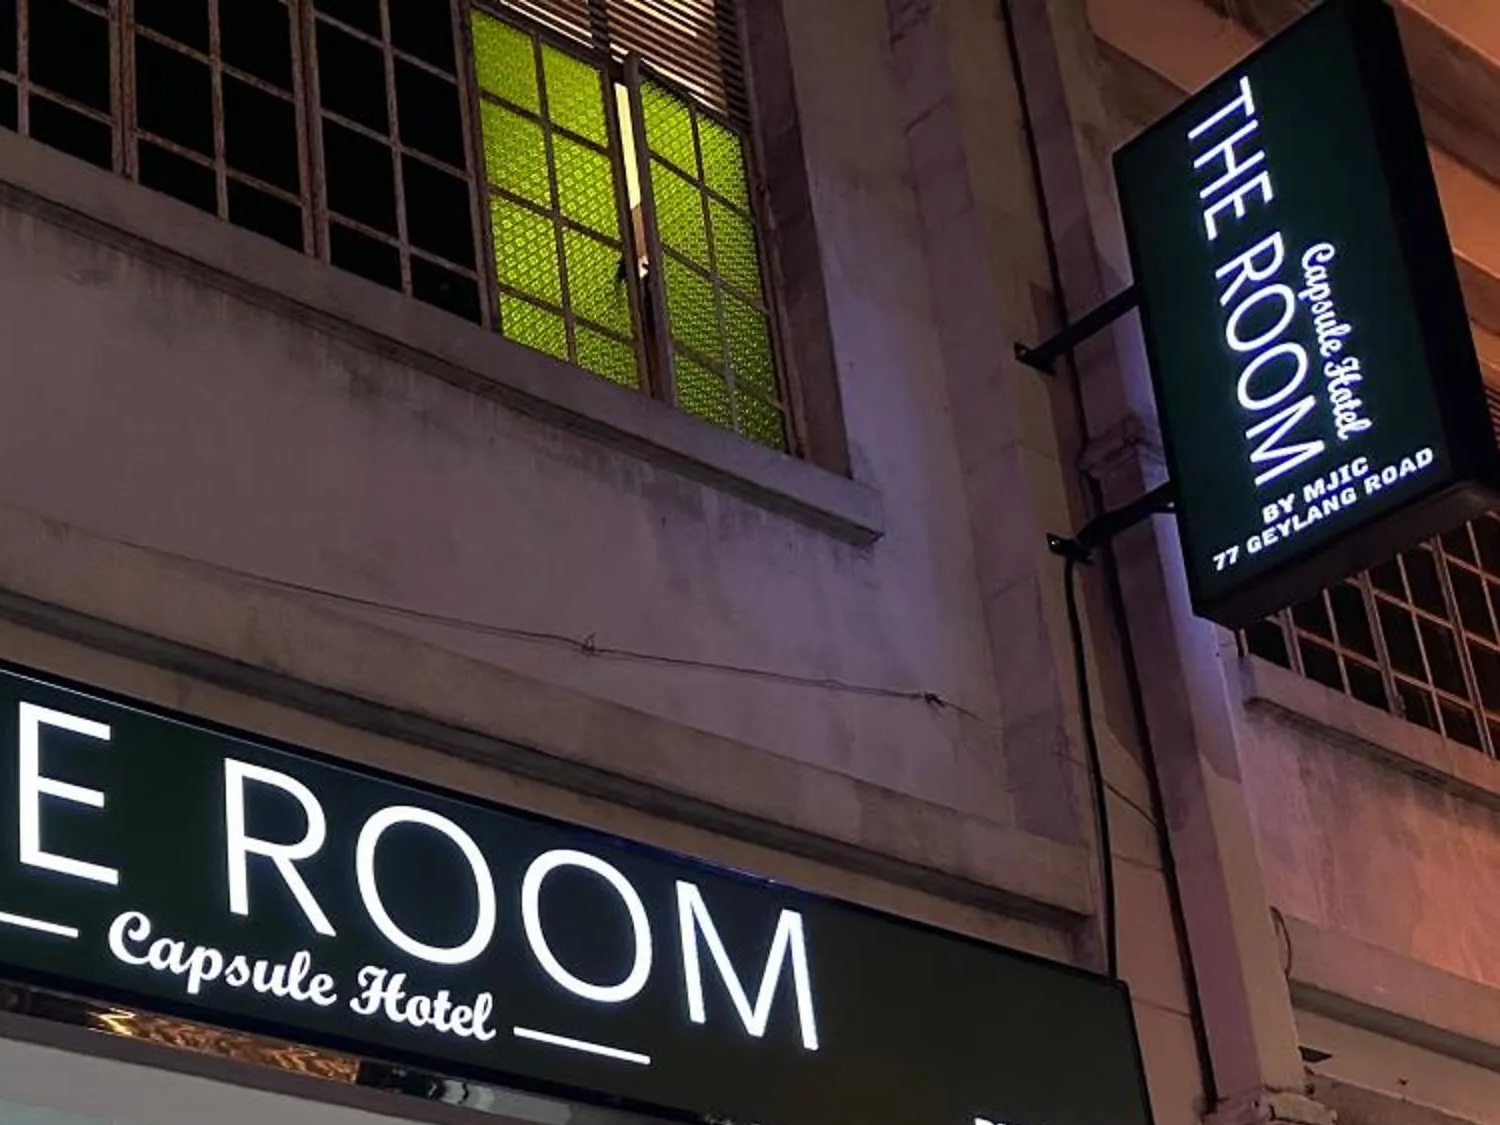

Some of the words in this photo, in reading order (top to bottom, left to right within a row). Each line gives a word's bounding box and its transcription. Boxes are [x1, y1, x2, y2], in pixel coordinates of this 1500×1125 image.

[1187, 76, 1274, 241] THE
[1215, 231, 1325, 487] ROOM
[1299, 243, 1352, 359] Capsule
[1323, 357, 1373, 440] Hotel
[1213, 548, 1240, 571] 77
[1246, 488, 1357, 554] GEYLANG
[1363, 447, 1433, 495] ROAD
[1262, 496, 1296, 525] BY
[1303, 456, 1370, 505] MJIC
[224, 757, 819, 1051] ROOM
[108, 911, 337, 1006] Capsule
[349, 965, 497, 1041] Hotel
